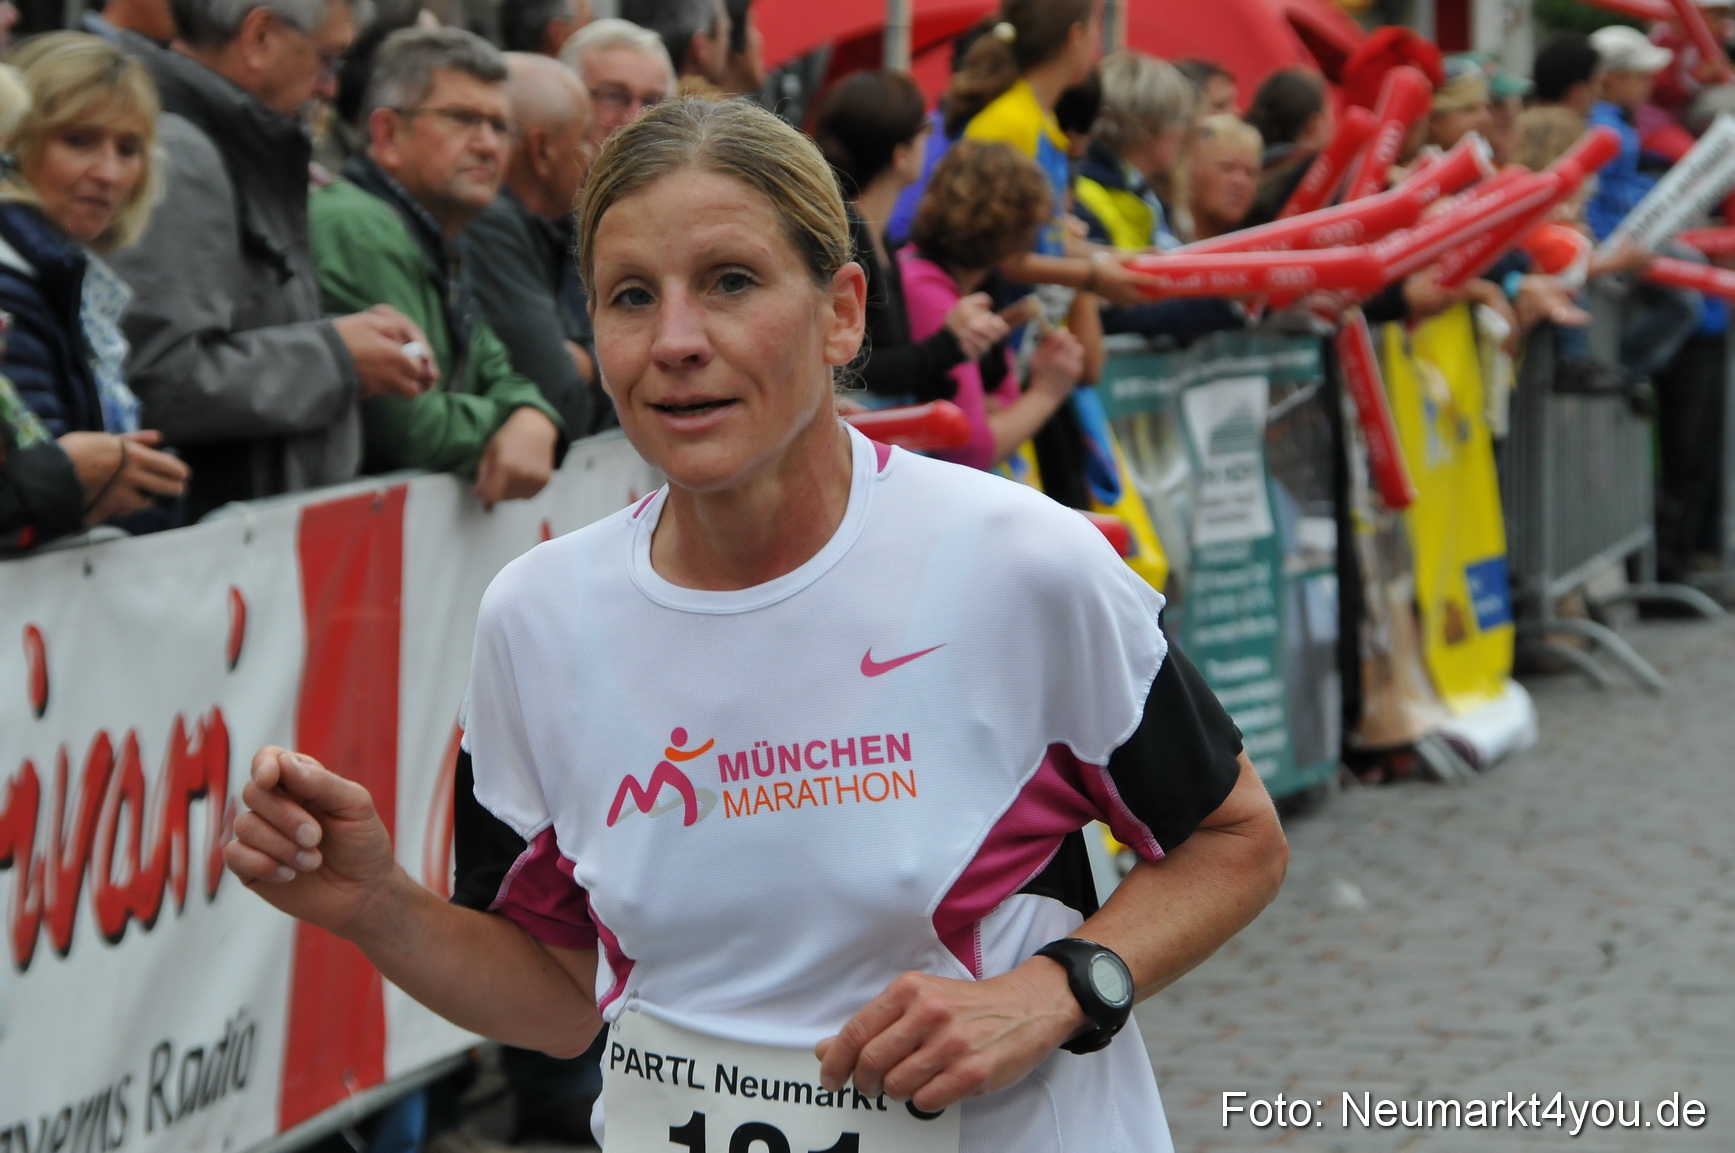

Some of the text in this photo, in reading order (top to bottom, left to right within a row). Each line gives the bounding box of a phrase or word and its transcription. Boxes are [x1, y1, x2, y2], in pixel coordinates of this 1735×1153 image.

[717, 732, 912, 783] MÜNCHEN
[722, 769, 917, 819] MARATHON
[145, 1005, 257, 1136] Radio
[609, 1041, 705, 1091] PARTL
[714, 1062, 888, 1112] Neumarkt
